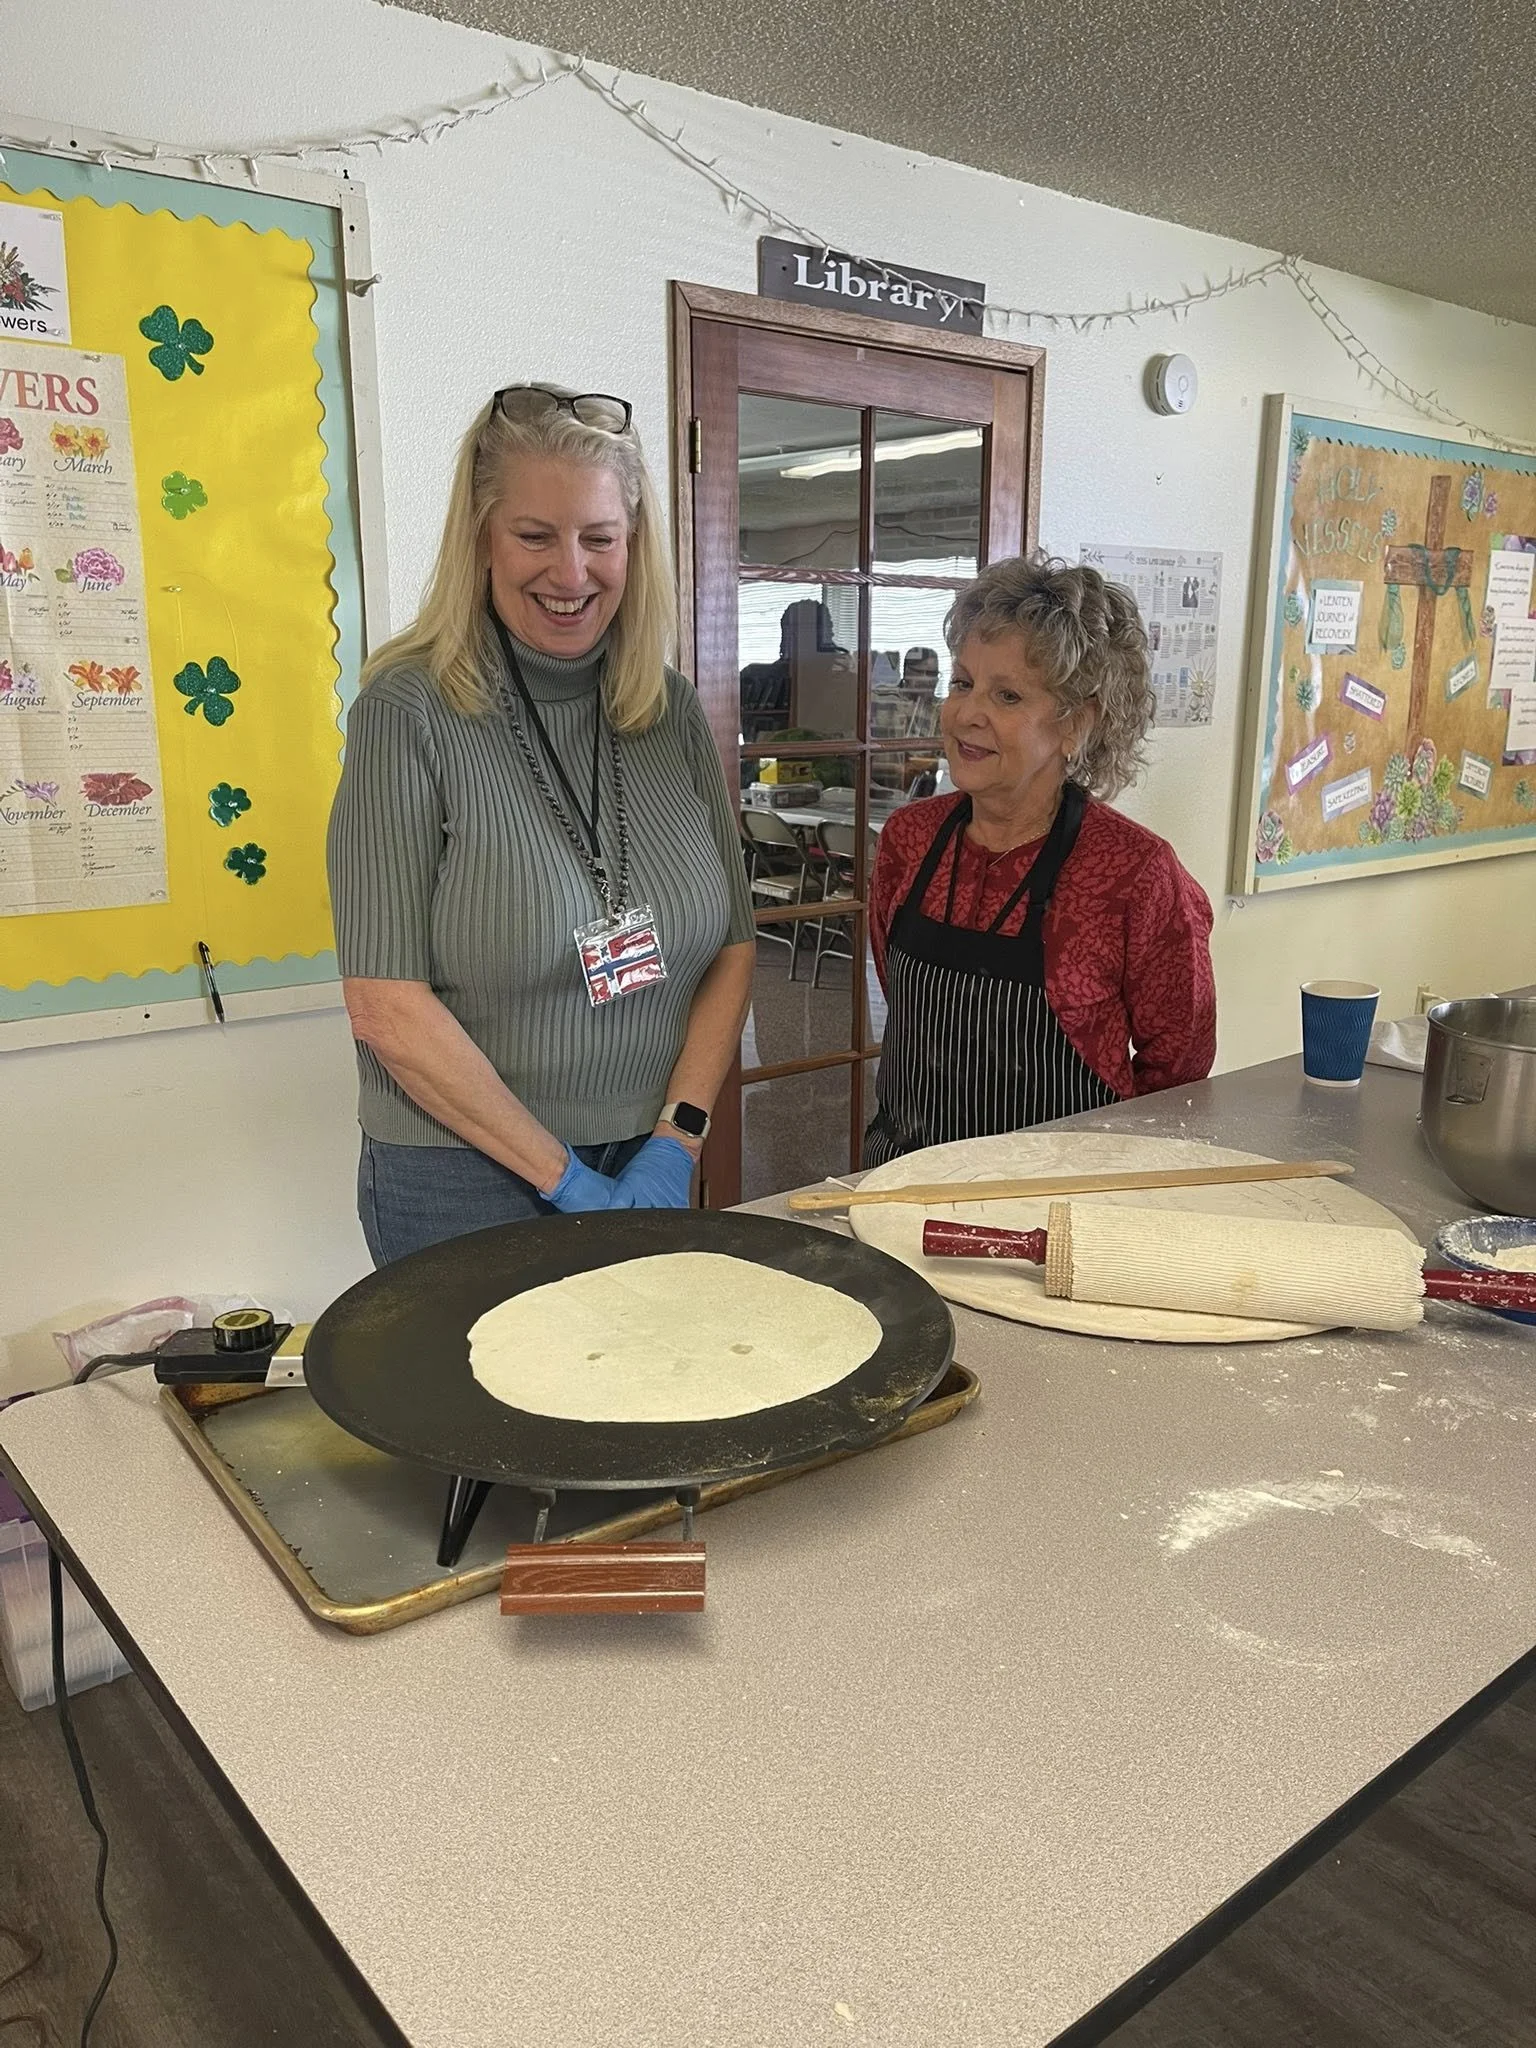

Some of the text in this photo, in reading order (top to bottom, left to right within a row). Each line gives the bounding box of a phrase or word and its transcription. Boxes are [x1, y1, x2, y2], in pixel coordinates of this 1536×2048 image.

[792, 253, 959, 322] Library
[0, 456, 113, 475] ary March
[79, 576, 113, 593] June
[1324, 595, 1353, 607] LENTEN
[1315, 611, 1348, 623] JOURNEY
[1315, 628, 1352, 639] RECOVERY
[0, 691, 143, 711] August September
[0, 802, 152, 826] November December
